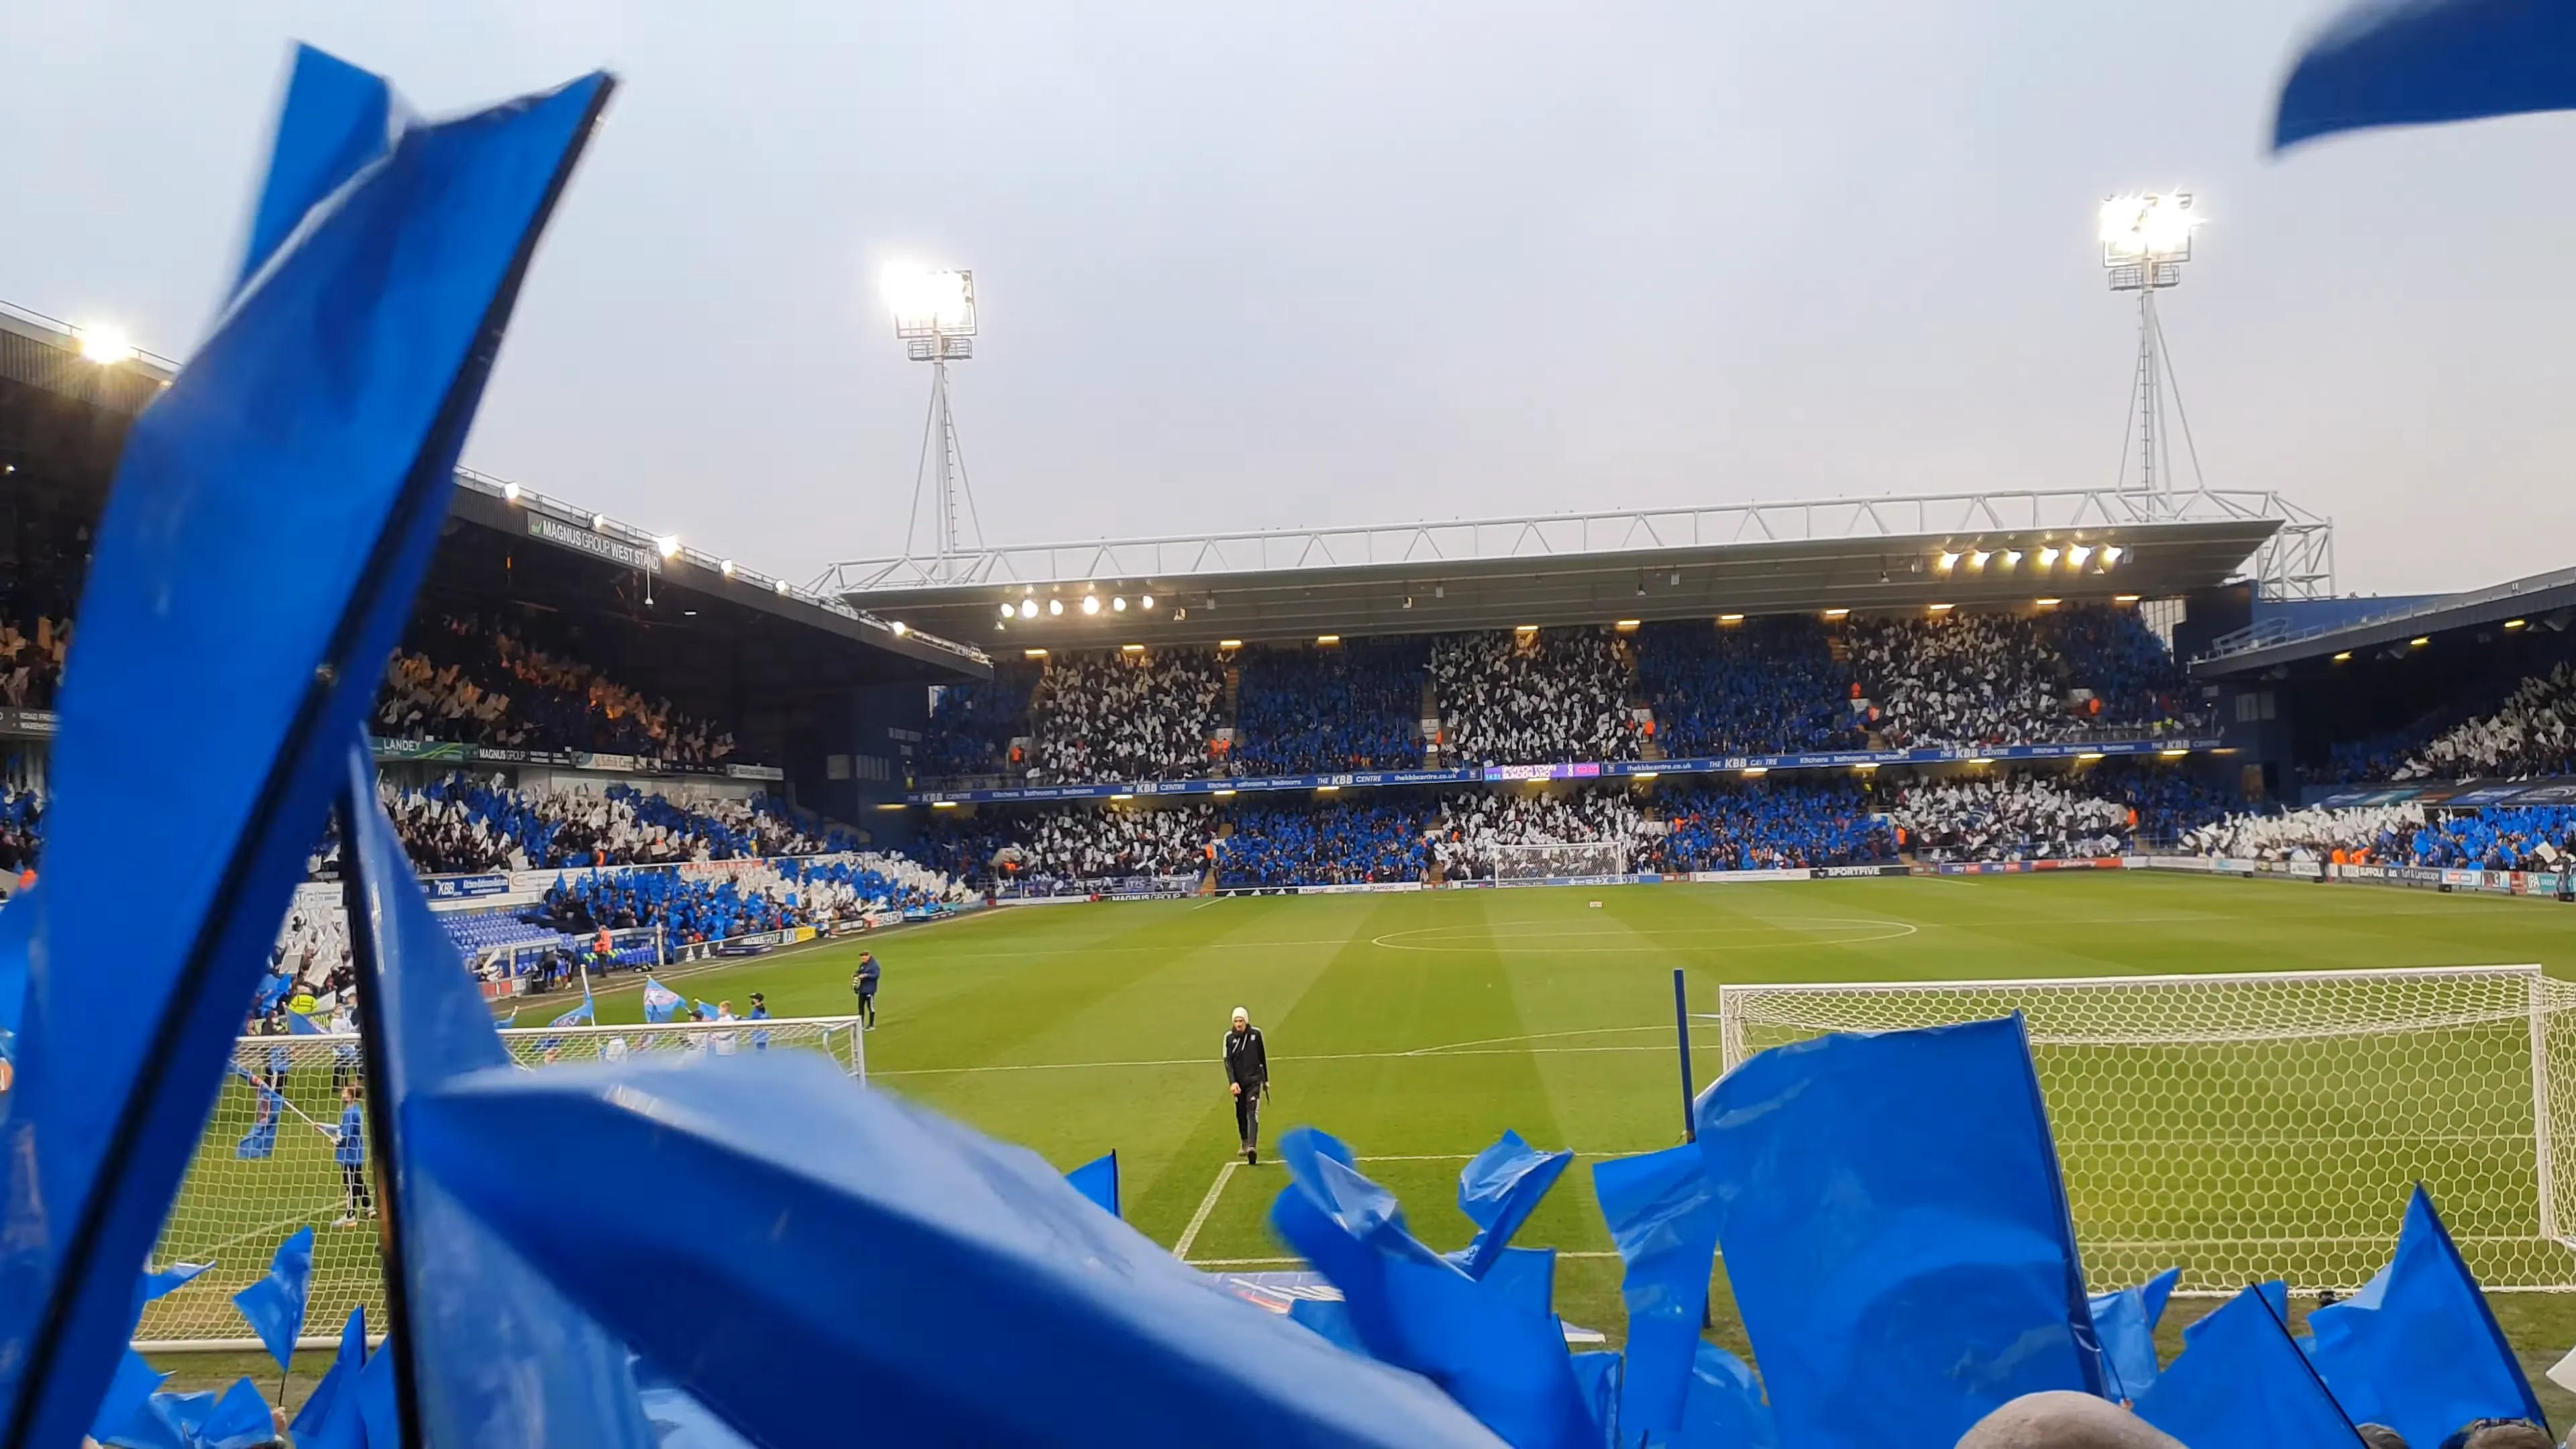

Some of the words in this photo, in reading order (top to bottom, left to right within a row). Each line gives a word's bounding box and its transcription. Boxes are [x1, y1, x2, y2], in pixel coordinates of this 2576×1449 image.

[543, 521, 582, 546] MAGNUS
[582, 533, 610, 553] GROUP
[611, 543, 633, 563] WEST
[635, 552, 659, 570] STAND
[384, 739, 421, 751] LANDEX
[479, 749, 506, 760] MAGNUS
[506, 751, 525, 761] GROUP
[1725, 758, 1746, 768] KBB
[1332, 775, 1353, 785] KBB
[1356, 775, 1382, 783] CENTRE
[1136, 783, 1157, 793] KBB
[1828, 867, 1880, 876] SPORTFIVE
[1952, 865, 1965, 873] sky
[1992, 863, 2004, 872] sky
[2360, 867, 2385, 877] SUFFOLK
[2527, 873, 2540, 890] IPA
[437, 881, 455, 896] KBB
[1112, 894, 1149, 902] MAGNUS
